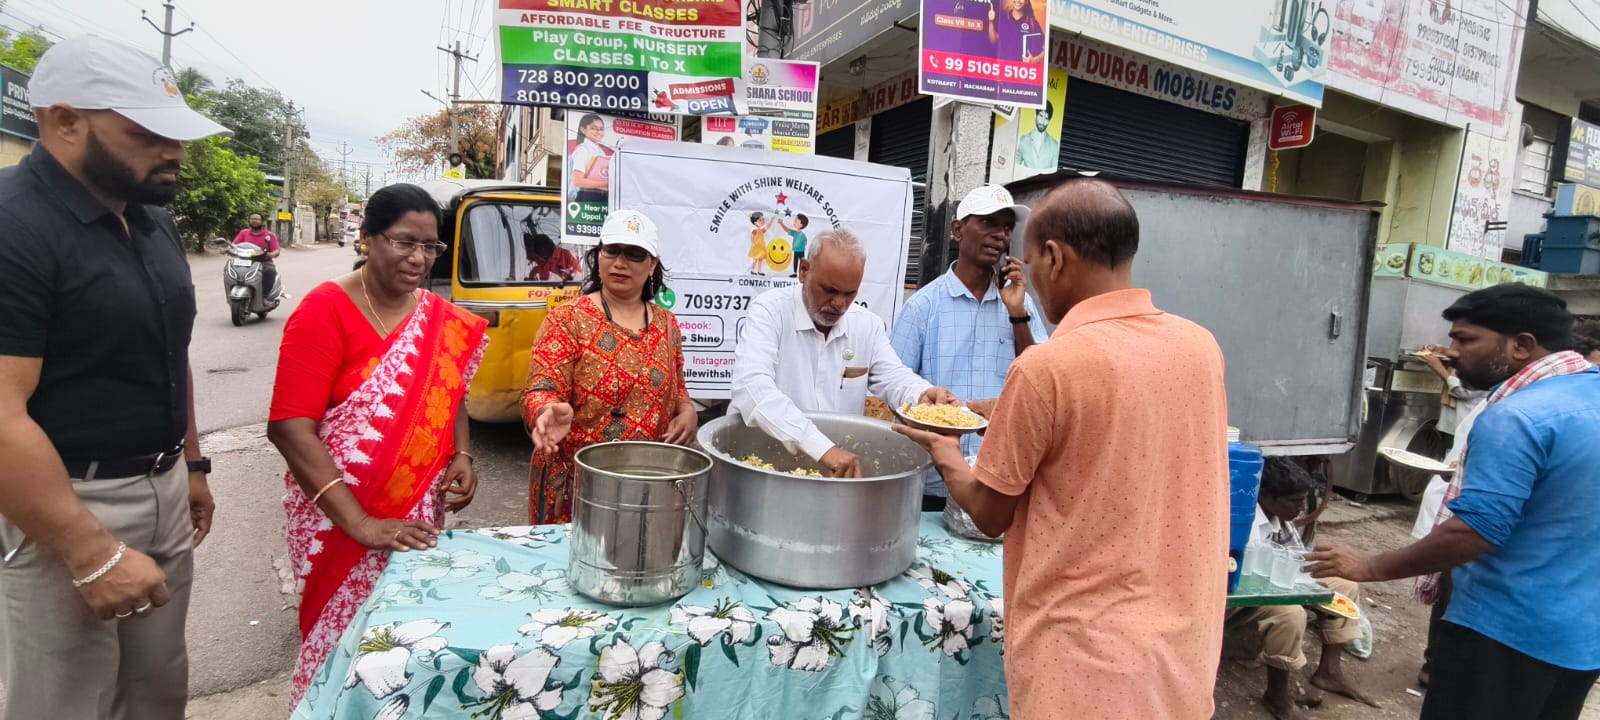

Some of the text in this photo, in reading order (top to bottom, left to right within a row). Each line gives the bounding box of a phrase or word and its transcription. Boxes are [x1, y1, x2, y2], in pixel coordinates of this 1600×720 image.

[547, 0, 699, 21] SMART CLASSES
[1129, 2, 1152, 18] Gadgets
[1153, 10, 1158, 18] &
[520, 13, 726, 39] AFFORDABLE FEE STRUCTURE
[1070, 4, 1120, 34] DURGA
[1122, 22, 1209, 62] ENTERPRISES
[532, 30, 708, 56] Play Group, NURSERY
[553, 48, 686, 72] CLASSES I To X
[944, 57, 1037, 80] 99 5105 5105
[518, 69, 640, 90] 728 800 2000
[927, 78, 957, 87] KOTHAPET
[1086, 48, 1149, 89] DURGA
[1153, 68, 1237, 111] MOBILES
[672, 83, 727, 95] ADMISSIONS
[746, 86, 813, 103] SHARA SCHOOL
[1001, 87, 1038, 97] NALLAKUNTA
[517, 89, 641, 110] 8019 008 009
[689, 97, 729, 112] OPEN
[866, 82, 898, 115] NAV
[816, 107, 840, 131] EAR
[1281, 120, 1304, 130] Airtel
[1280, 128, 1303, 137] Wi-Fi
[584, 204, 601, 212] Near
[709, 176, 841, 234] SMILE WITH SHINE WELFARE SOCIE
[576, 224, 602, 235] 93988
[738, 278, 771, 288] CONTACT
[684, 293, 751, 311] 7093737
[679, 320, 712, 330] ebook:
[690, 333, 721, 343] Shine
[692, 355, 736, 367] Instagram
